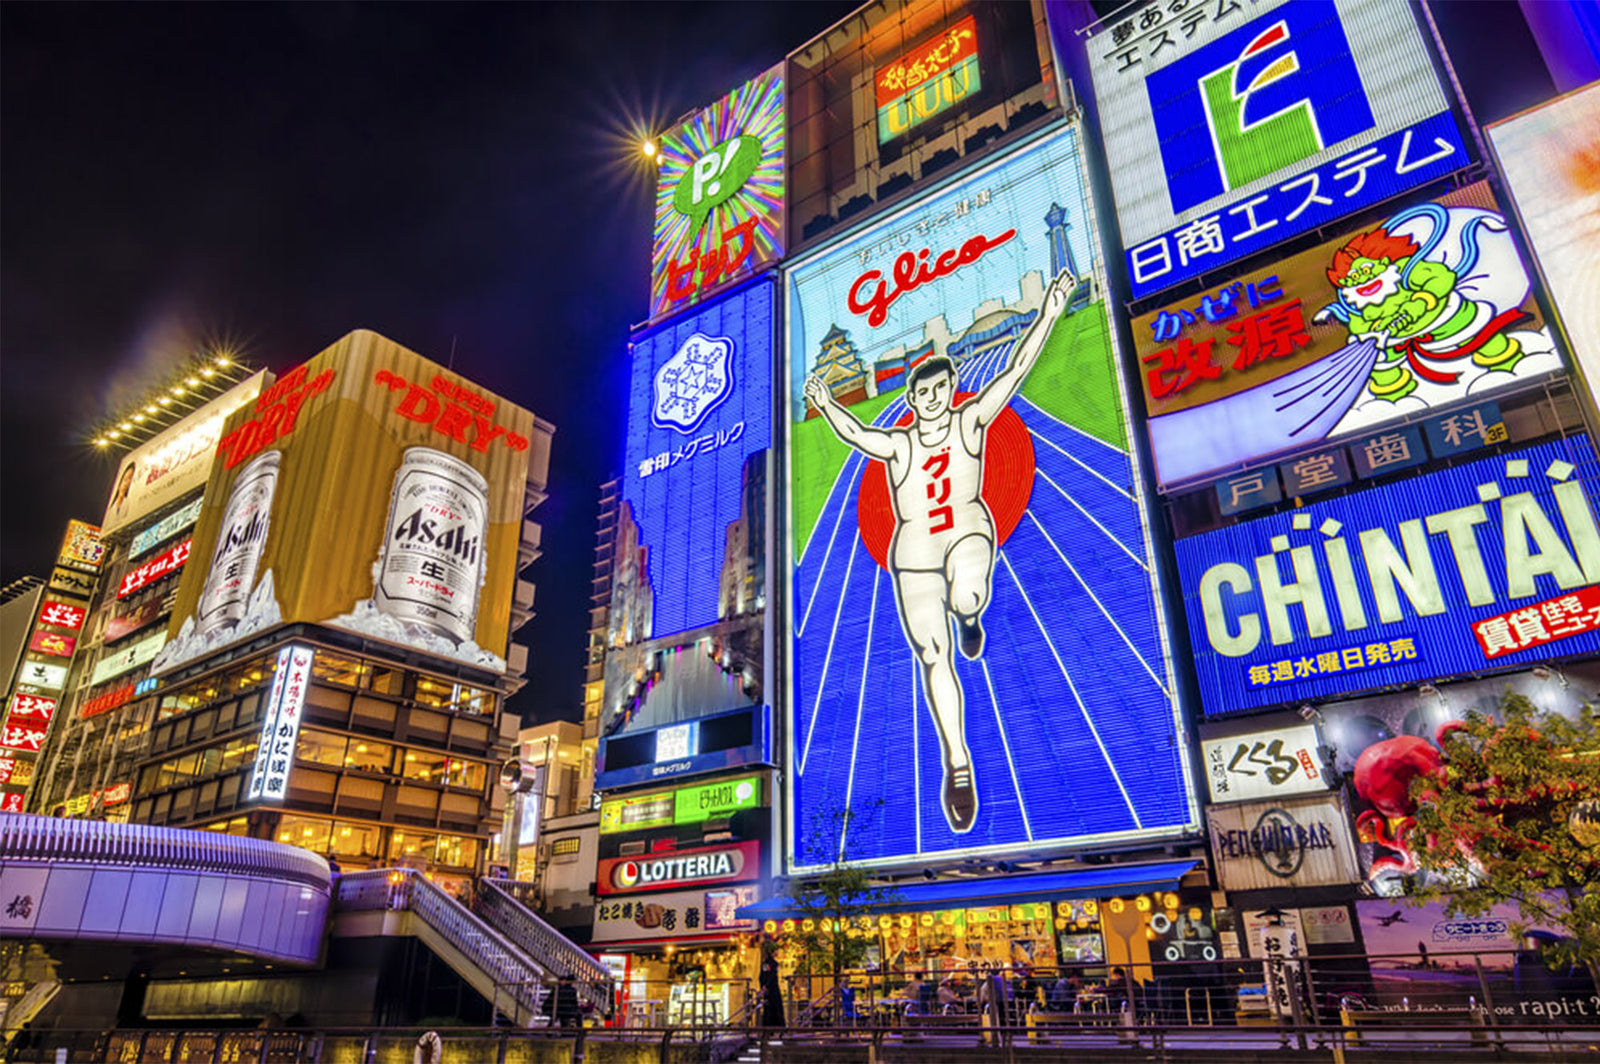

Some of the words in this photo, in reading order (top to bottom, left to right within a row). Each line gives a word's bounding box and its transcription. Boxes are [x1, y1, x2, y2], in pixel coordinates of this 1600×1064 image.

[1130, 129, 1456, 284] 日商エステム
[667, 216, 760, 301] ピップ
[848, 228, 1018, 328] Glico
[1150, 274, 1284, 342] かぜに
[1142, 298, 1312, 399] 改源
[429, 374, 497, 418] SUPER
[638, 421, 745, 479] 雪印メグミルク
[1228, 409, 1488, 508] 戸堂歯科
[1488, 427, 1505, 442] 3F
[921, 446, 954, 535] グリコ
[395, 507, 480, 567] Asahi
[1199, 459, 1600, 658] CHINTAI
[421, 560, 445, 582] 生
[1477, 607, 1550, 656] 賃貸
[1541, 595, 1583, 622] 住宅
[1248, 637, 1418, 687] 毎週水曜日発売
[13, 697, 54, 718] はや
[2, 727, 46, 749] はや
[1227, 739, 1299, 785] くくる
[1295, 821, 1337, 851] BAR
[641, 853, 731, 882] LOTTERIA
[6, 895, 33, 919] 橋
